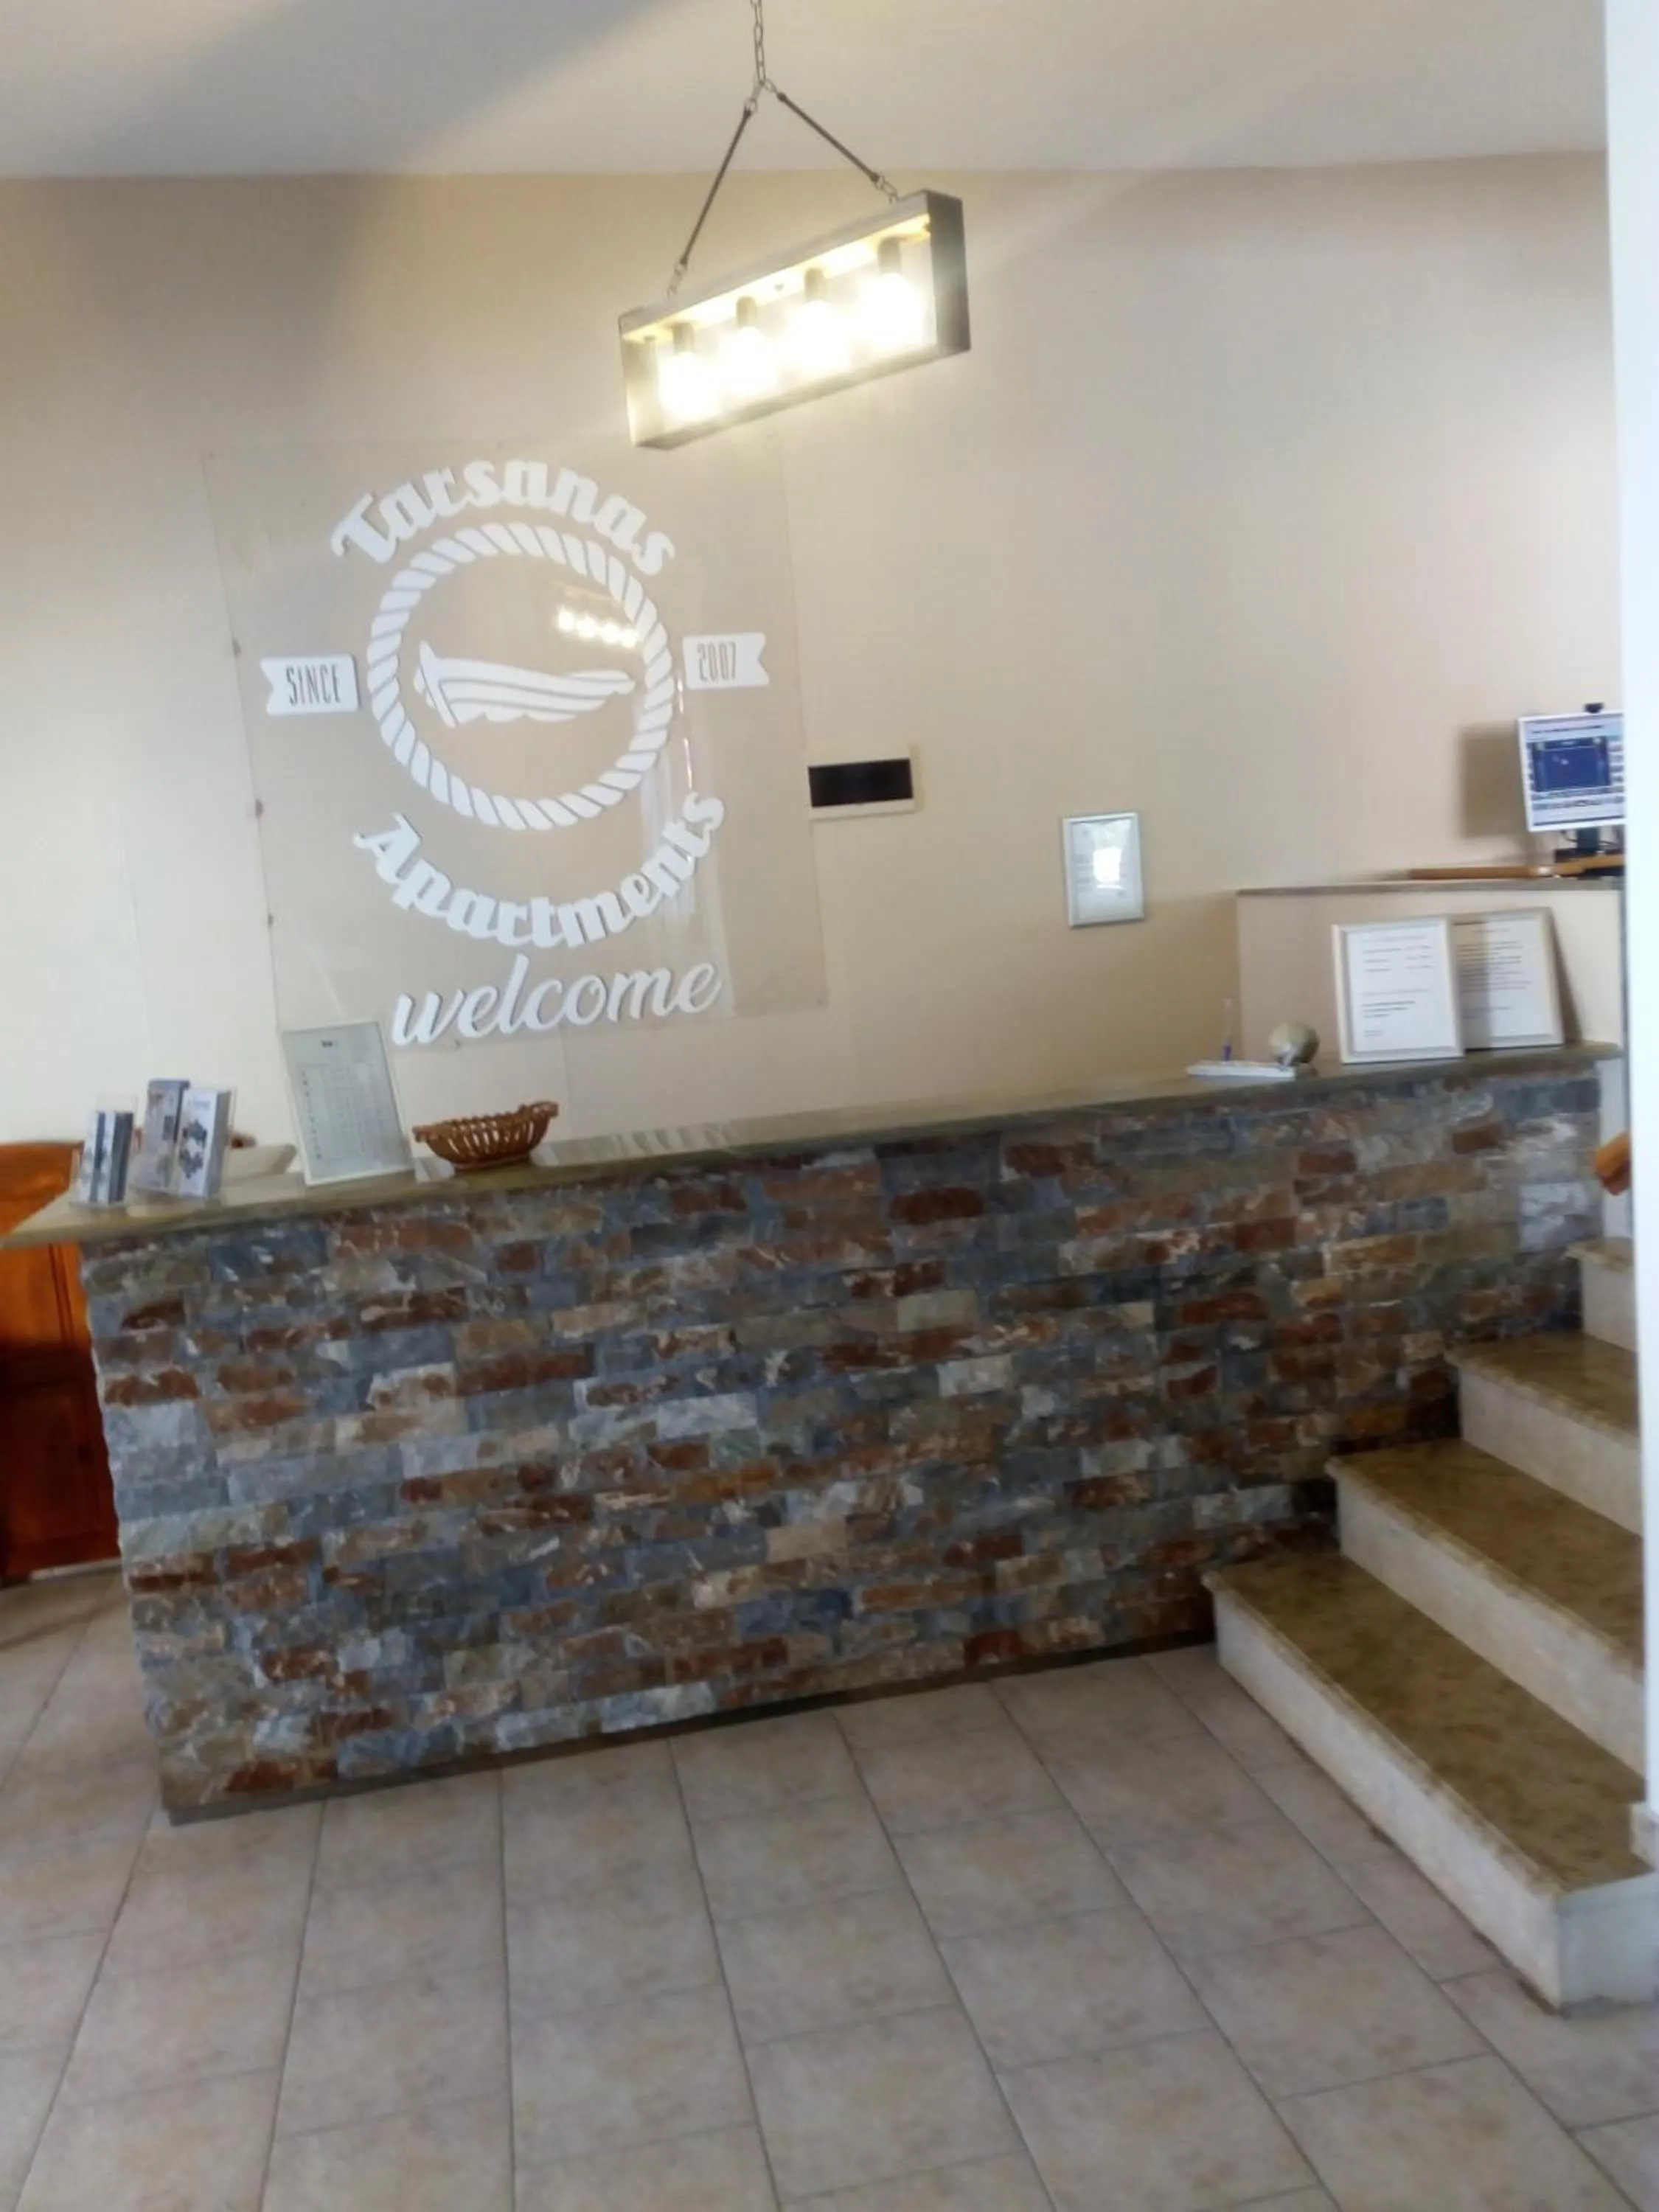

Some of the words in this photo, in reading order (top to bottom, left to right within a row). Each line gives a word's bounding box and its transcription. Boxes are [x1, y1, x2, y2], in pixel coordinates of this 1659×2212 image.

[331, 459, 675, 575] Tarsanas
[285, 664, 341, 706] SINCE
[697, 641, 737, 682] 2007
[354, 792, 723, 948] Apartments
[392, 954, 722, 1046] welcome
